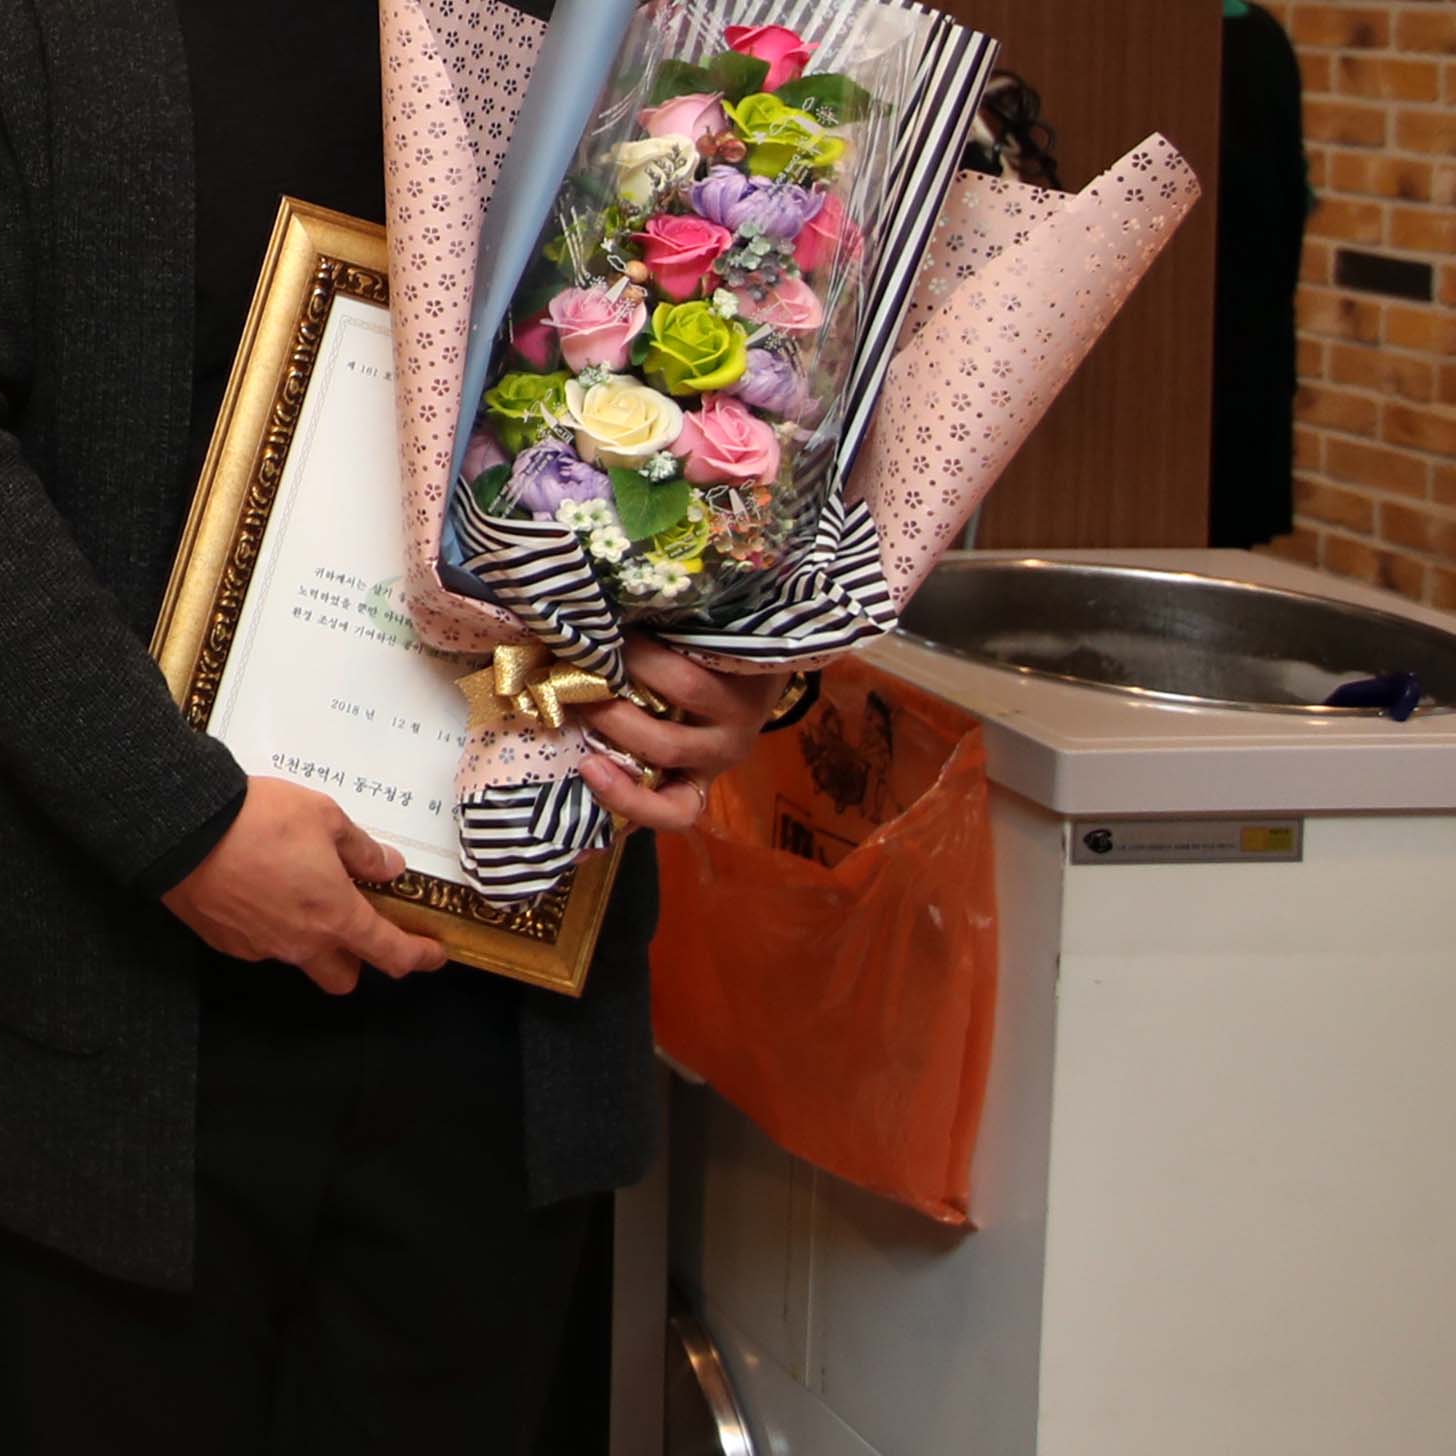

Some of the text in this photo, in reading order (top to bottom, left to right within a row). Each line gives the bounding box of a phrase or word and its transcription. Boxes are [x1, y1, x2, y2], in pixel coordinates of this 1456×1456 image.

[330, 698, 361, 717] 2018
[390, 715, 406, 729] 12
[435, 729, 451, 744] 14
[271, 752, 346, 787] 인천광역시
[352, 775, 414, 808] 동구청장
